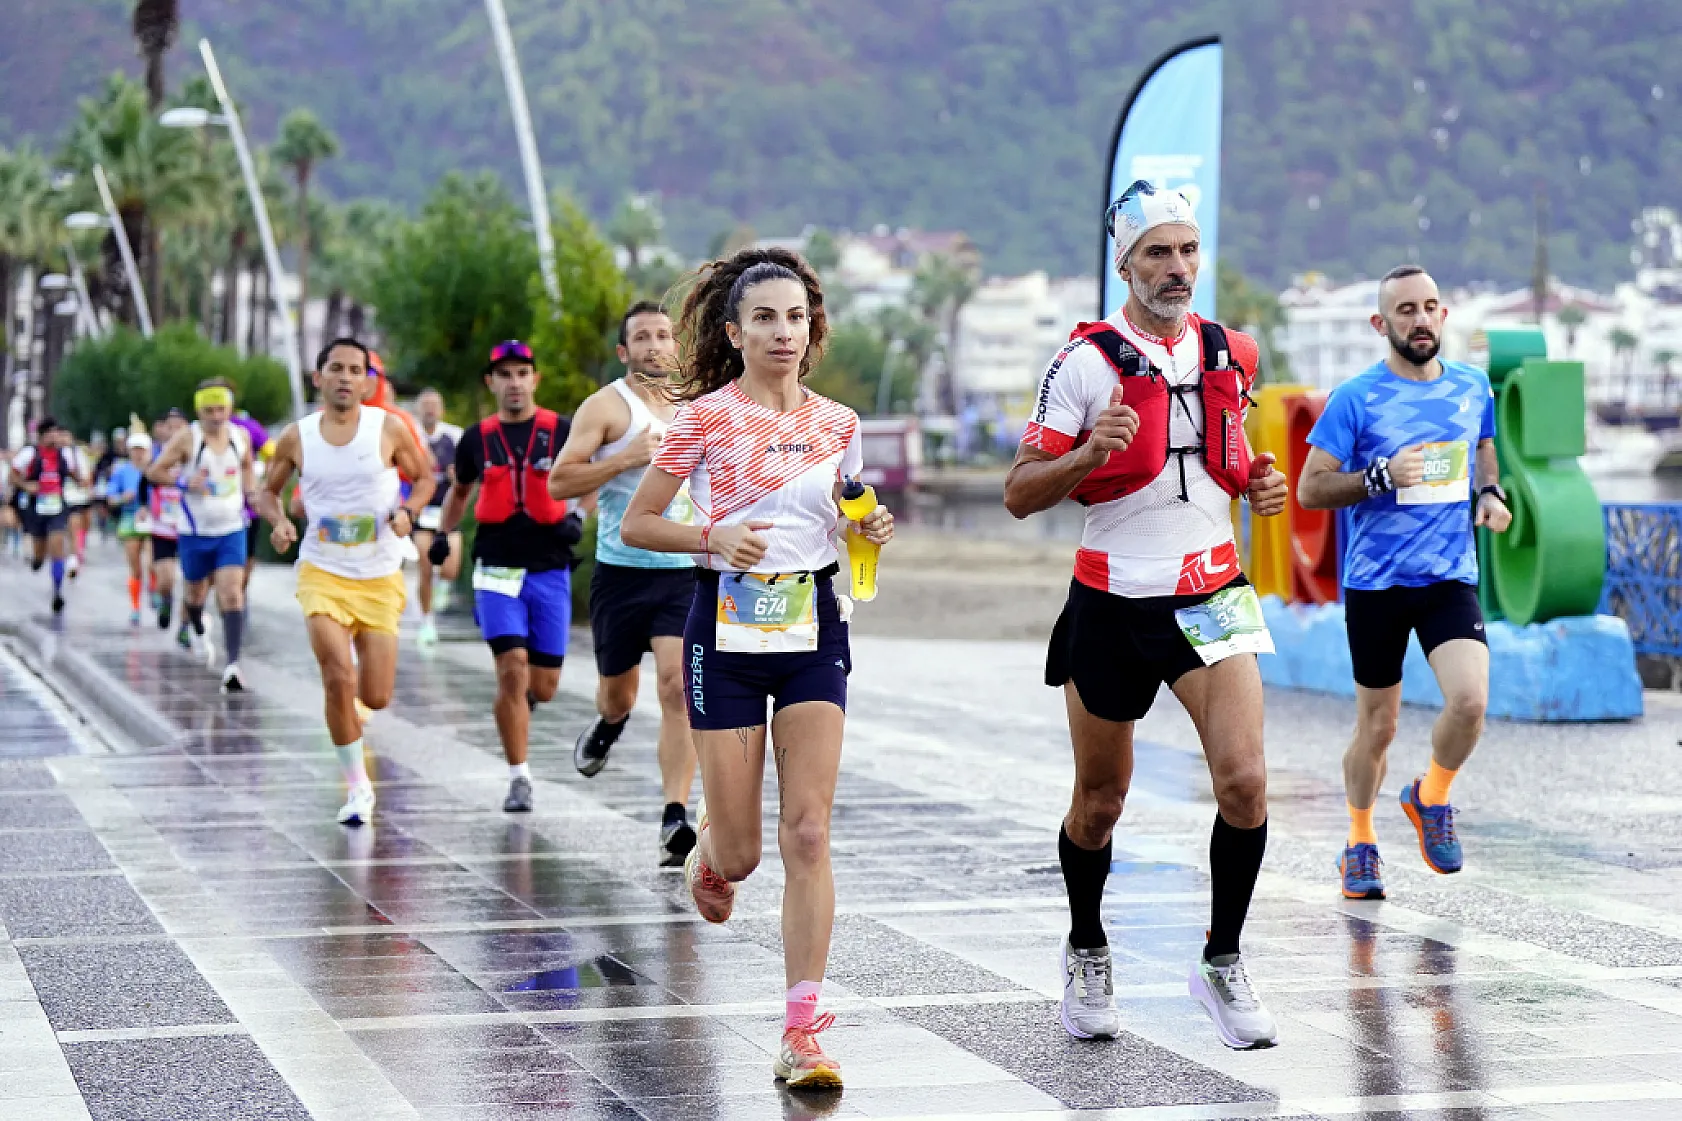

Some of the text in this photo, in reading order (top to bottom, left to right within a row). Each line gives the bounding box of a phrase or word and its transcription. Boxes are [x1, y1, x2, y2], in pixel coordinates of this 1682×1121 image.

[1424, 458, 1451, 475] 805
[754, 597, 787, 616] 674
[690, 643, 707, 717] ADIZERO
